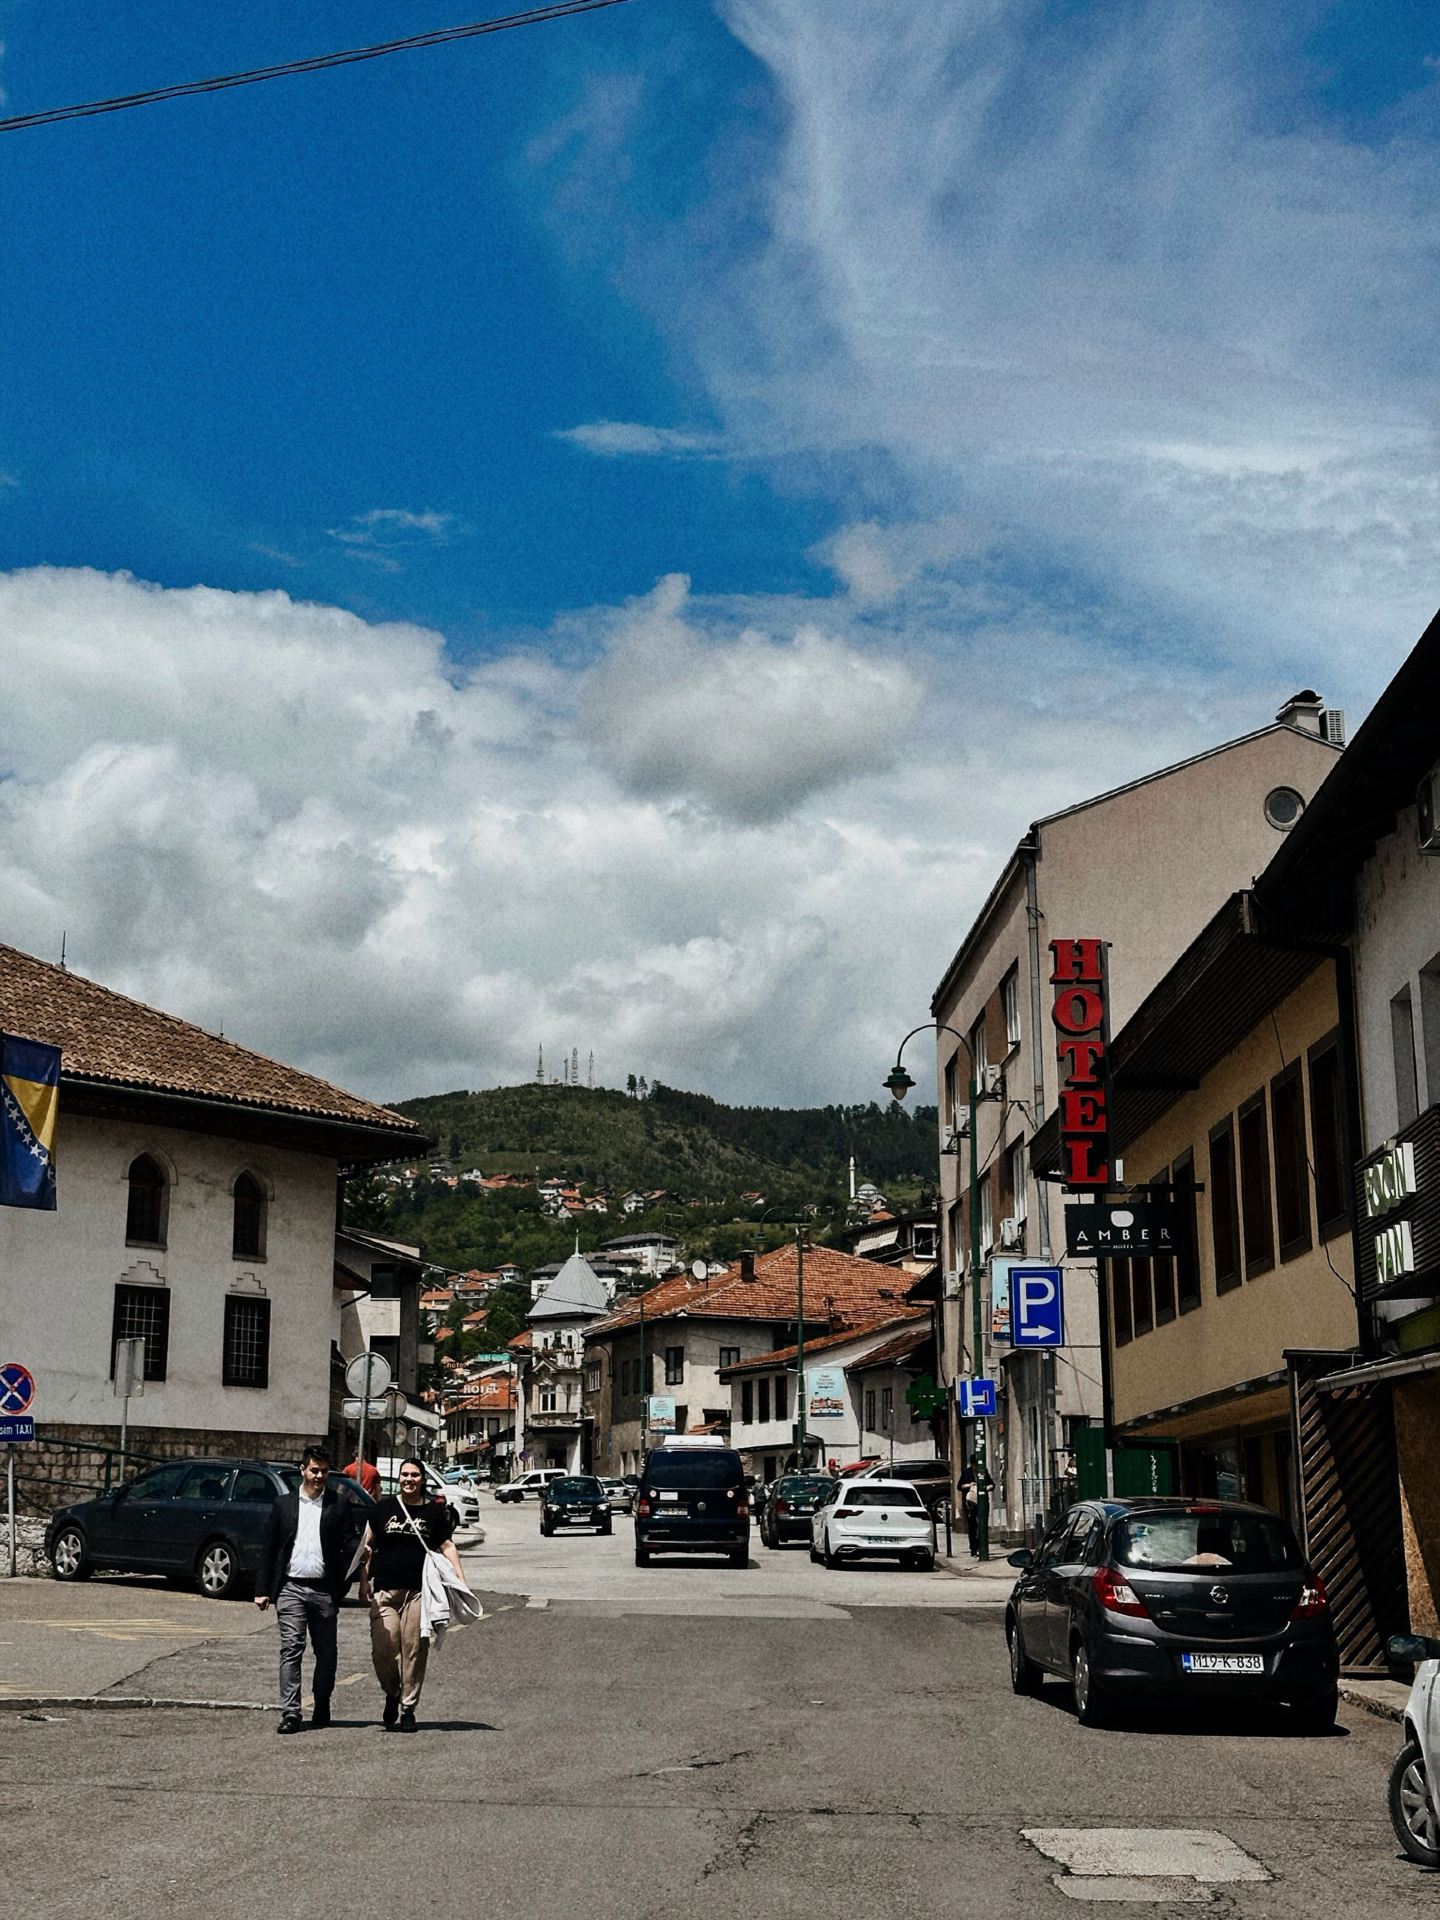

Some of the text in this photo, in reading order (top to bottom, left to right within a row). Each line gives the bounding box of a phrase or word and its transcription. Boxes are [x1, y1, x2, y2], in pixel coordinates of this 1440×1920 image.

[1050, 939, 1108, 1184] HOTEL
[1076, 1227, 1171, 1242] AMBER
[1019, 1277, 1055, 1324] P
[463, 1383, 499, 1394] HOTEL
[15, 1424, 32, 1435] TAXI
[469, 1434, 477, 1444] P
[1192, 1654, 1261, 1669] M19-K-838
